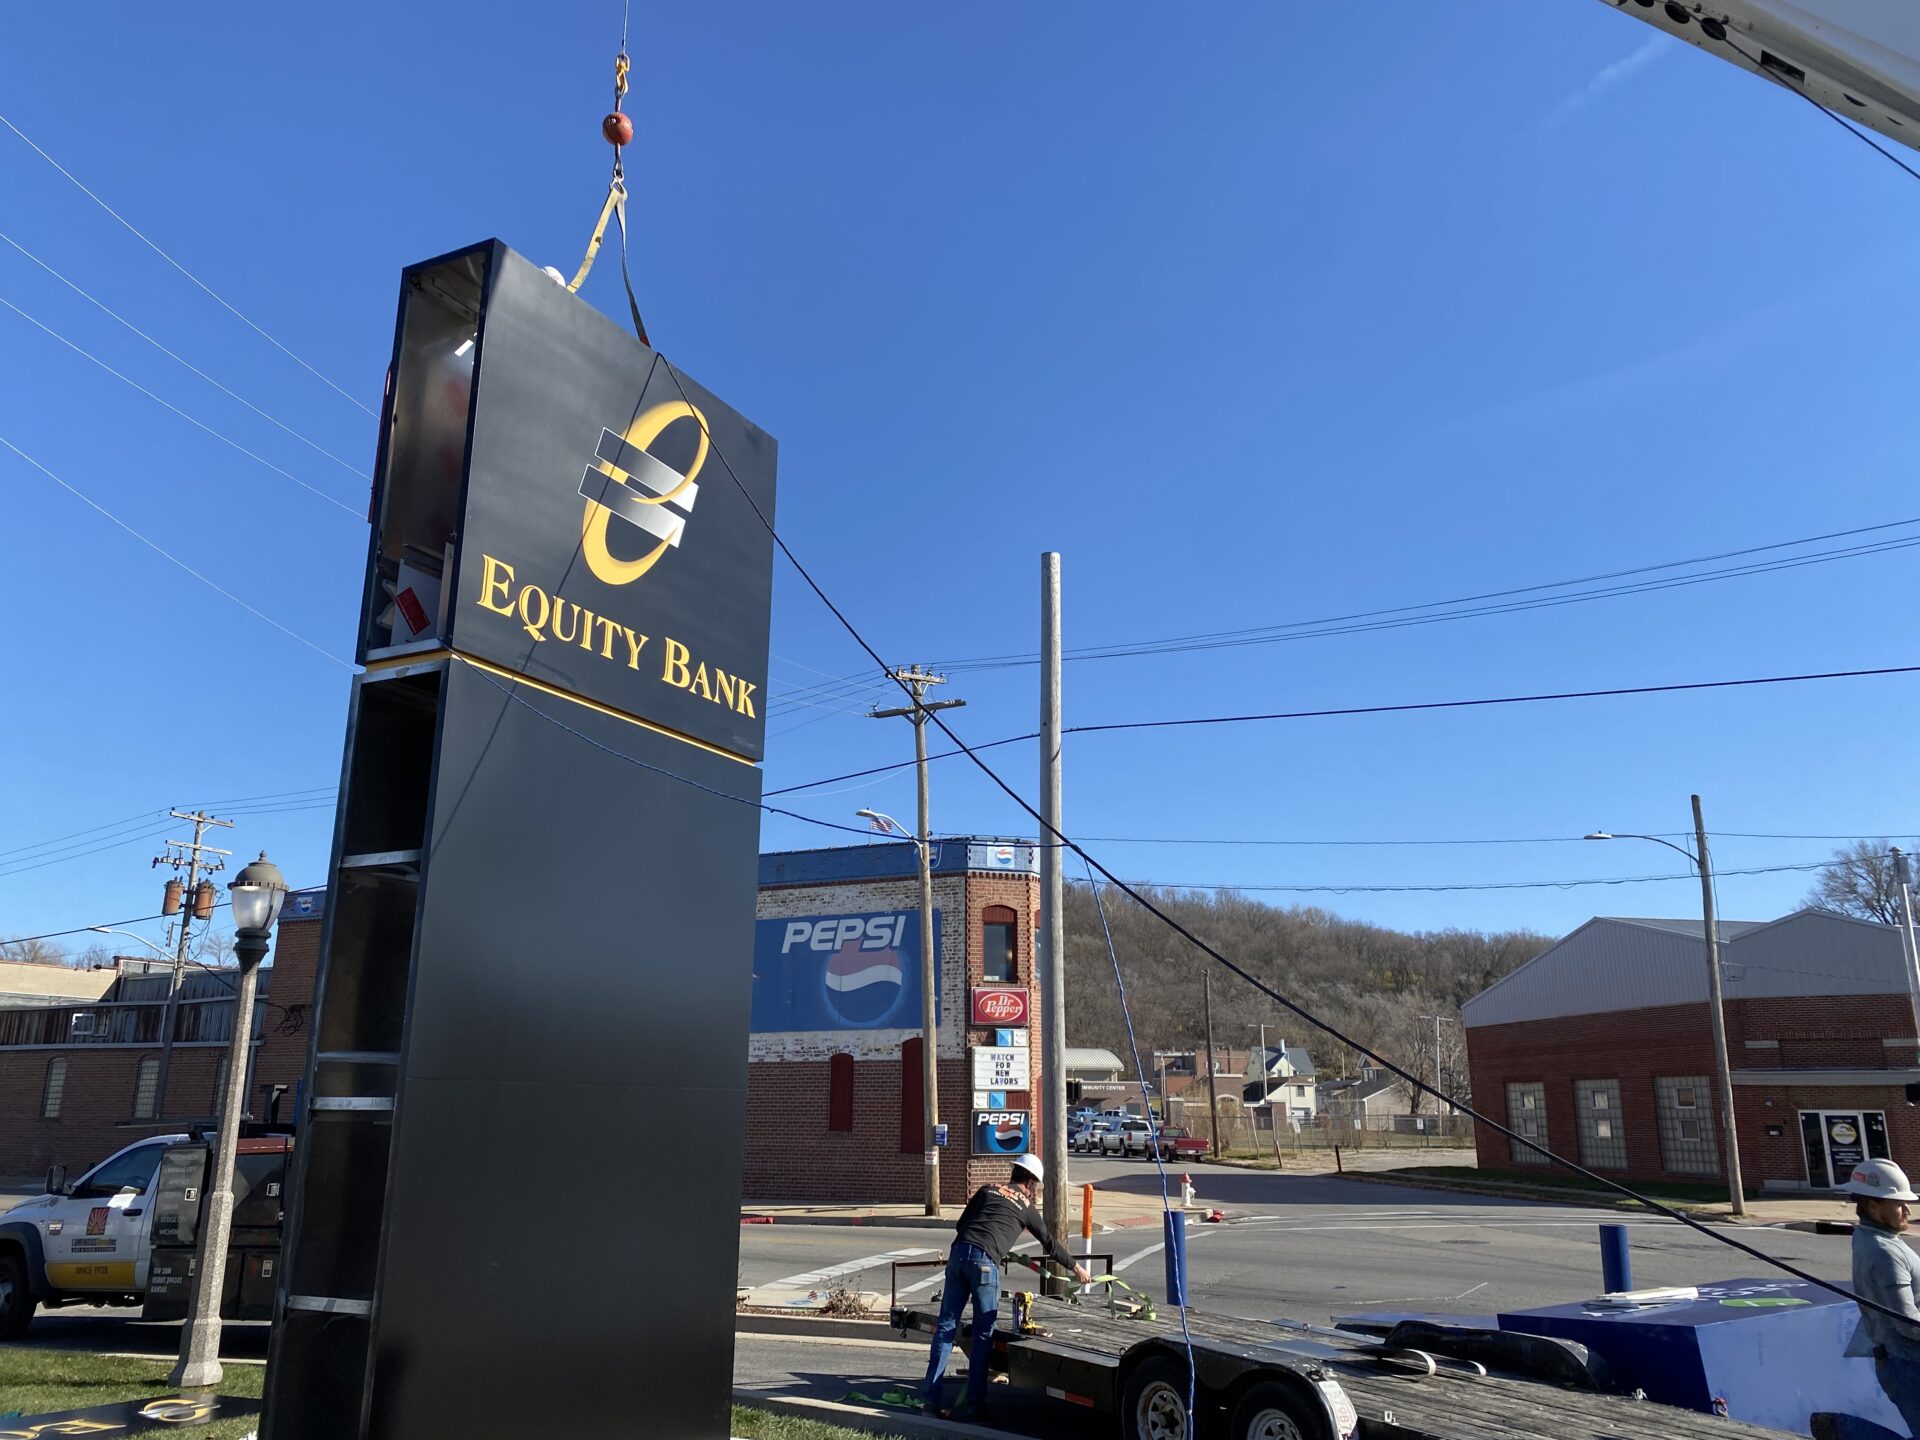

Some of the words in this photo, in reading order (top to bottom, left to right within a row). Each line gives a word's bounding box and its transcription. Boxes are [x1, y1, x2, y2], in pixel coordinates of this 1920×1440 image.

[476, 553, 650, 671] EQUITY
[661, 636, 758, 719] BANK
[781, 915, 907, 954] PEPSI
[997, 995, 1019, 1006] Dr
[985, 1000, 1021, 1017] Pepper
[990, 1053, 1015, 1061] WATCH
[990, 1077, 1019, 1085] LAVORS
[977, 1112, 1026, 1126] PEPSI
